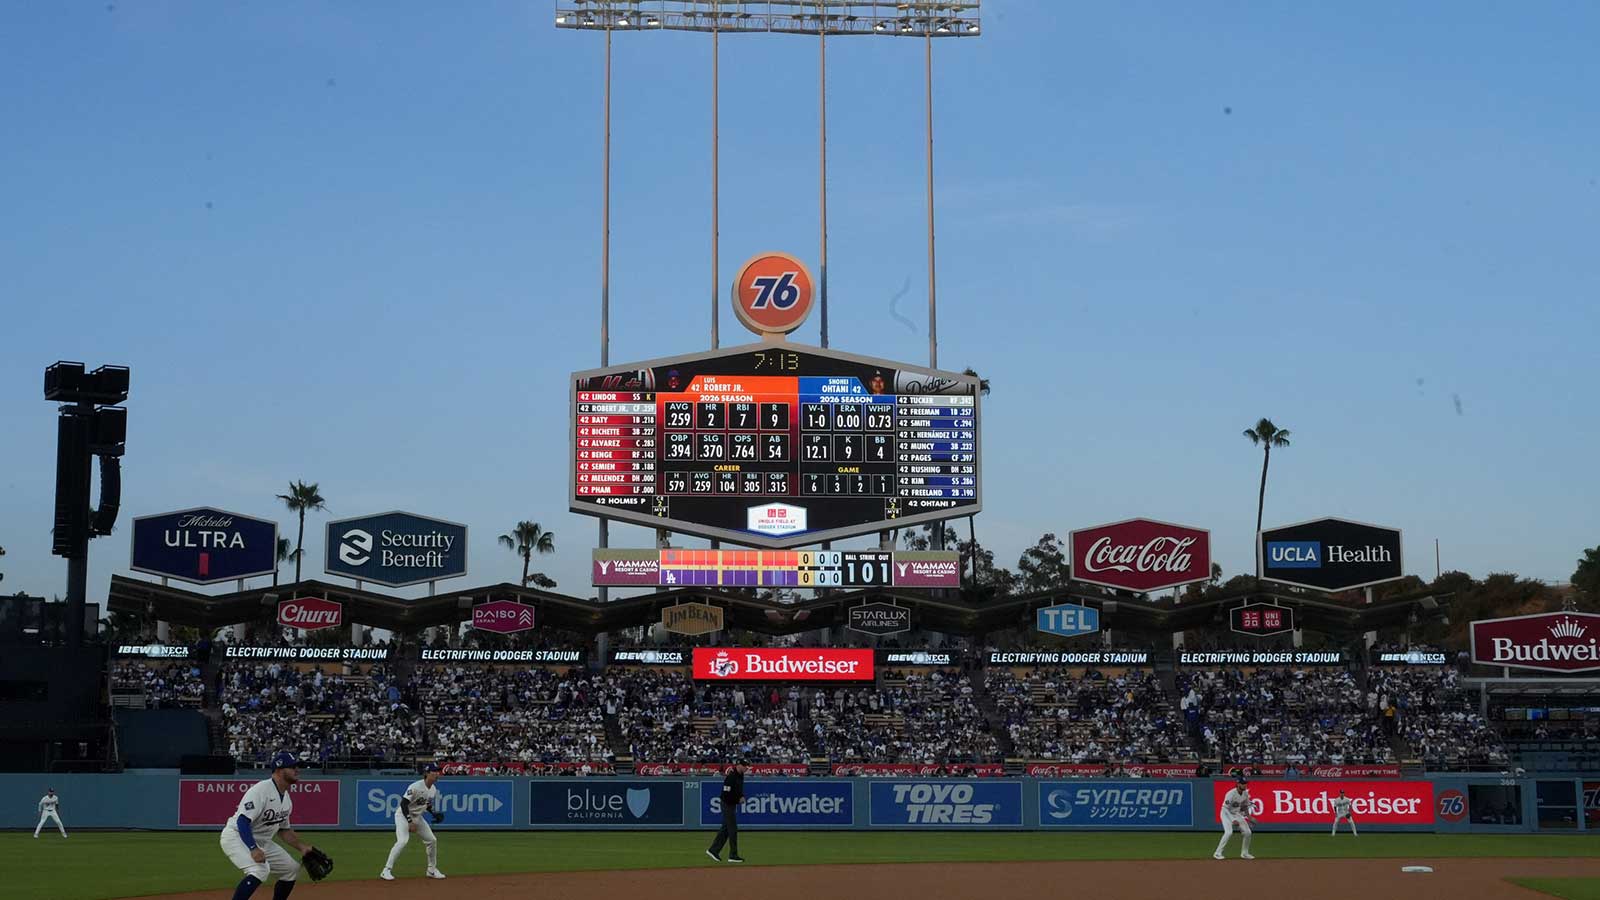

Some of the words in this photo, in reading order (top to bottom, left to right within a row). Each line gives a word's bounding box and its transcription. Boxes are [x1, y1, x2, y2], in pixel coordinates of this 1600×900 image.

[750, 271, 800, 310] 76
[755, 354, 798, 370] 7:13
[733, 384, 744, 392] JR.
[668, 413, 691, 426] .259
[708, 414, 714, 426] 2
[740, 414, 746, 426] 7
[772, 414, 778, 426] 9
[809, 415, 825, 427] 1-0
[837, 415, 859, 427] 0.00
[869, 415, 891, 428] 0.73
[668, 445, 690, 457] .394
[700, 445, 722, 457] .370
[732, 445, 754, 457] .764
[769, 446, 781, 458] 54
[806, 446, 827, 458] 12.1
[845, 446, 851, 459] 9
[877, 447, 883, 459] 4
[669, 481, 684, 491] 579
[720, 481, 735, 491] 104
[744, 482, 760, 491] 305
[178, 515, 232, 528] Michelob
[165, 530, 245, 548] ULTRA
[382, 530, 454, 551] Security
[382, 550, 444, 567] Benefit
[803, 554, 809, 564] 0
[820, 554, 825, 564] 0
[833, 554, 839, 564] 0
[1085, 536, 1197, 572] Coca-Cola
[1272, 547, 1316, 561] UCLA
[1328, 545, 1391, 562] Health
[667, 570, 676, 583] LA
[803, 572, 809, 583] 0
[820, 573, 826, 583] 0
[833, 573, 839, 583] 0
[848, 563, 854, 582] 1
[861, 563, 873, 583] 0
[881, 563, 888, 583] 1
[281, 604, 338, 622] Churu
[476, 610, 516, 618] DAISO
[666, 608, 687, 628] JIM
[688, 605, 718, 626] BEAM
[852, 610, 907, 620] STARLUX
[1044, 610, 1091, 630] TEL
[118, 646, 152, 654] IBEW
[161, 646, 189, 654] NECA
[226, 647, 297, 657] ELECTRIFYING
[300, 648, 340, 658] DODGER
[343, 649, 387, 659] STADIUM
[422, 650, 491, 660] ELECTRIFYING
[493, 650, 533, 660] DODGER
[536, 651, 579, 661] STADIUM
[1492, 638, 1600, 661] Budwei
[615, 652, 646, 660] IBEW
[656, 652, 683, 660] NECA
[925, 654, 950, 662] NECA
[991, 653, 1059, 663] ELECTRIFYING
[1061, 653, 1100, 663] DODGER
[1103, 653, 1147, 663] STADIUM
[1181, 653, 1250, 663] ELECTRIFYING
[1253, 653, 1293, 663] DODGER
[1295, 653, 1340, 663] STADIUM
[1381, 653, 1410, 661] IBEW
[1420, 653, 1446, 661] NECA
[745, 654, 858, 673] Budweiser
[1313, 767, 1343, 778] Coca-Cola
[197, 783, 235, 793] BANK
[893, 784, 974, 803] TOYO
[368, 788, 493, 818] Sptrum
[567, 788, 623, 810] blue
[1075, 789, 1183, 805] SYNCRON
[1440, 796, 1464, 815] 76
[906, 804, 994, 823] TIRES
[1089, 806, 1168, 818] シンクロンコーワ
